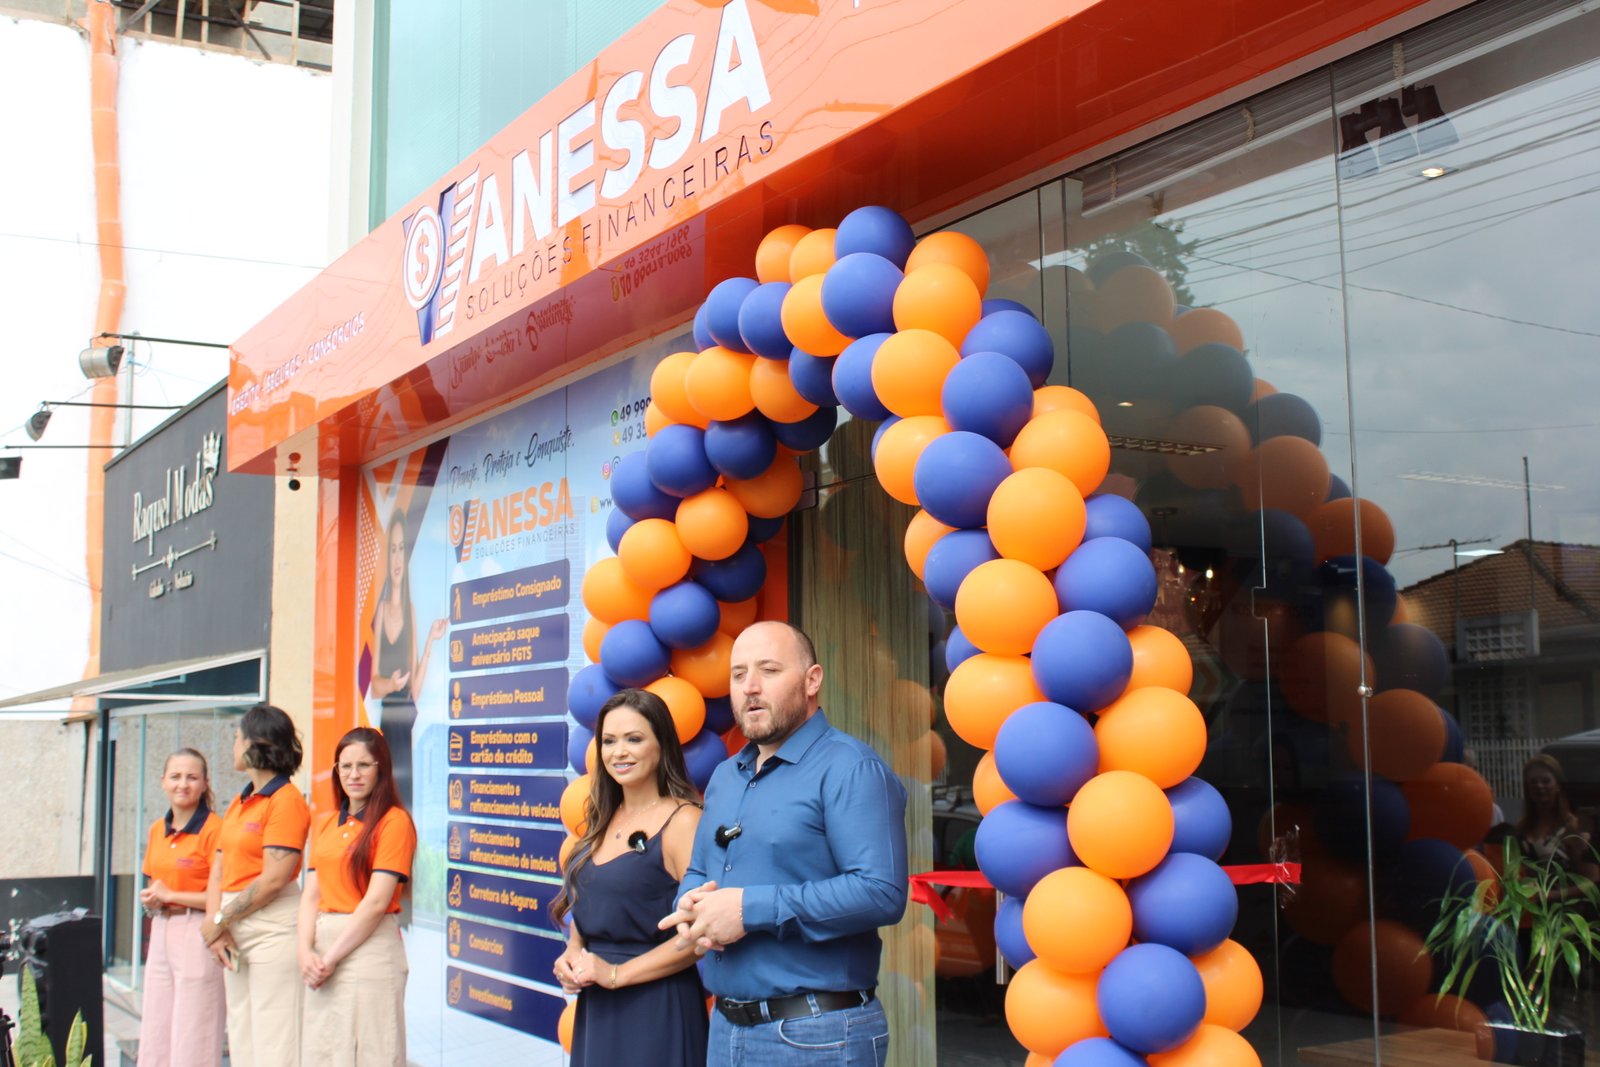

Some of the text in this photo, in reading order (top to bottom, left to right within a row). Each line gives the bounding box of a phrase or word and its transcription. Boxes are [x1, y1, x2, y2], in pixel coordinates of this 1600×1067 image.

[465, 120, 775, 320] SOLUÇÕES FINANCEIRAS
[620, 404, 631, 422] 49
[622, 425, 634, 443] 49
[517, 523, 575, 547] FINANCEIRAS
[472, 575, 561, 608] Empréstimo Consignado
[472, 627, 540, 647] Antecipação saque
[471, 646, 532, 665] aniversário FGTS
[471, 687, 544, 709] Empréstimo Pessoal
[471, 730, 538, 746] Empréstimo com o
[471, 749, 533, 764] cartão de crédito
[470, 780, 520, 796] Financiamento e
[470, 800, 560, 819] refinanciamento de veículos
[470, 829, 520, 848] Financiamento e
[521, 856, 529, 870] de
[530, 856, 557, 873] imóveis
[469, 885, 538, 912] Corretora de Seguros
[469, 934, 504, 955] Consórcios
